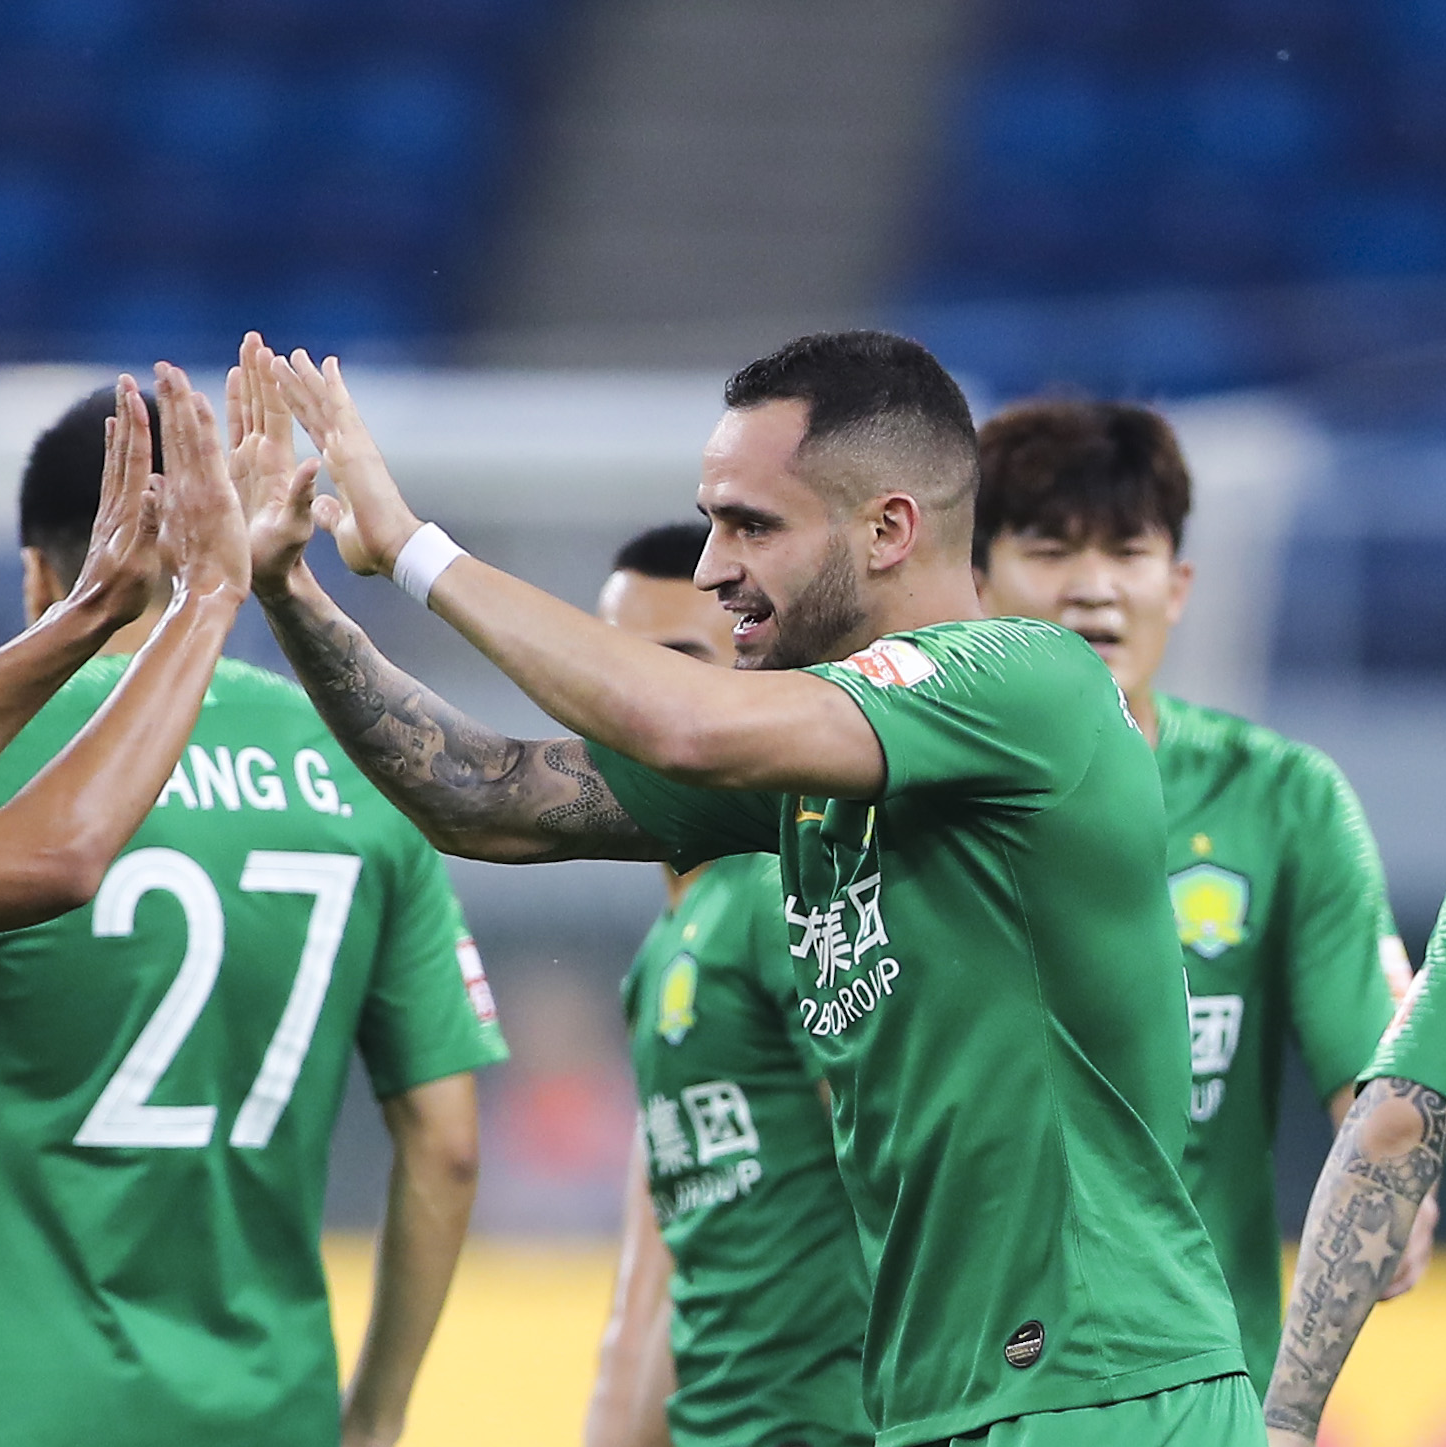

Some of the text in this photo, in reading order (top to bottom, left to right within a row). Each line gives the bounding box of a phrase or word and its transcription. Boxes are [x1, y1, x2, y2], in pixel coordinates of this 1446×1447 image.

[156, 744, 354, 818] ANG G.
[73, 847, 363, 1149] 27
